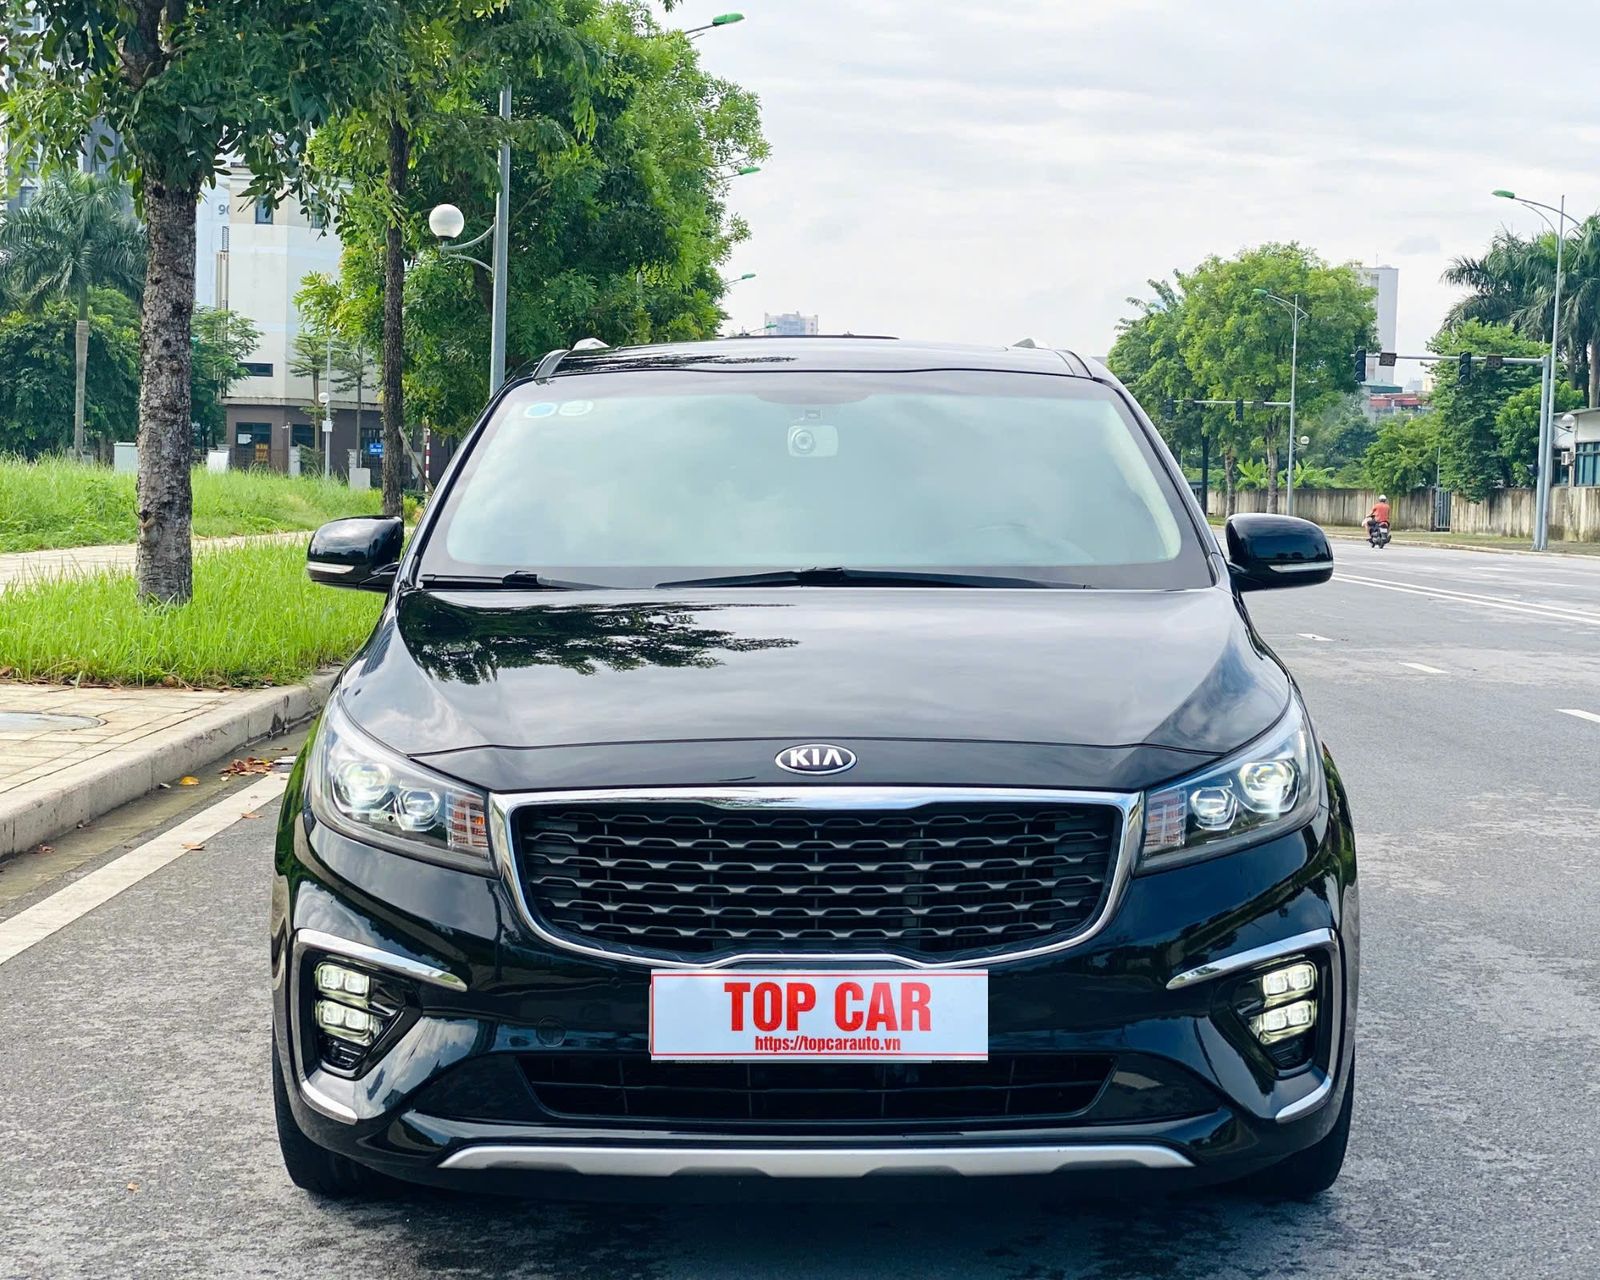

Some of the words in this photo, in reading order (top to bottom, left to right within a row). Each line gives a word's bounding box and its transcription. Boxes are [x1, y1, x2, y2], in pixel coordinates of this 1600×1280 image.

[789, 748, 844, 767] KIA
[724, 981, 817, 1032] TOP
[834, 981, 931, 1032] CAR
[755, 1035, 901, 1053] https://topcarauto.vn
